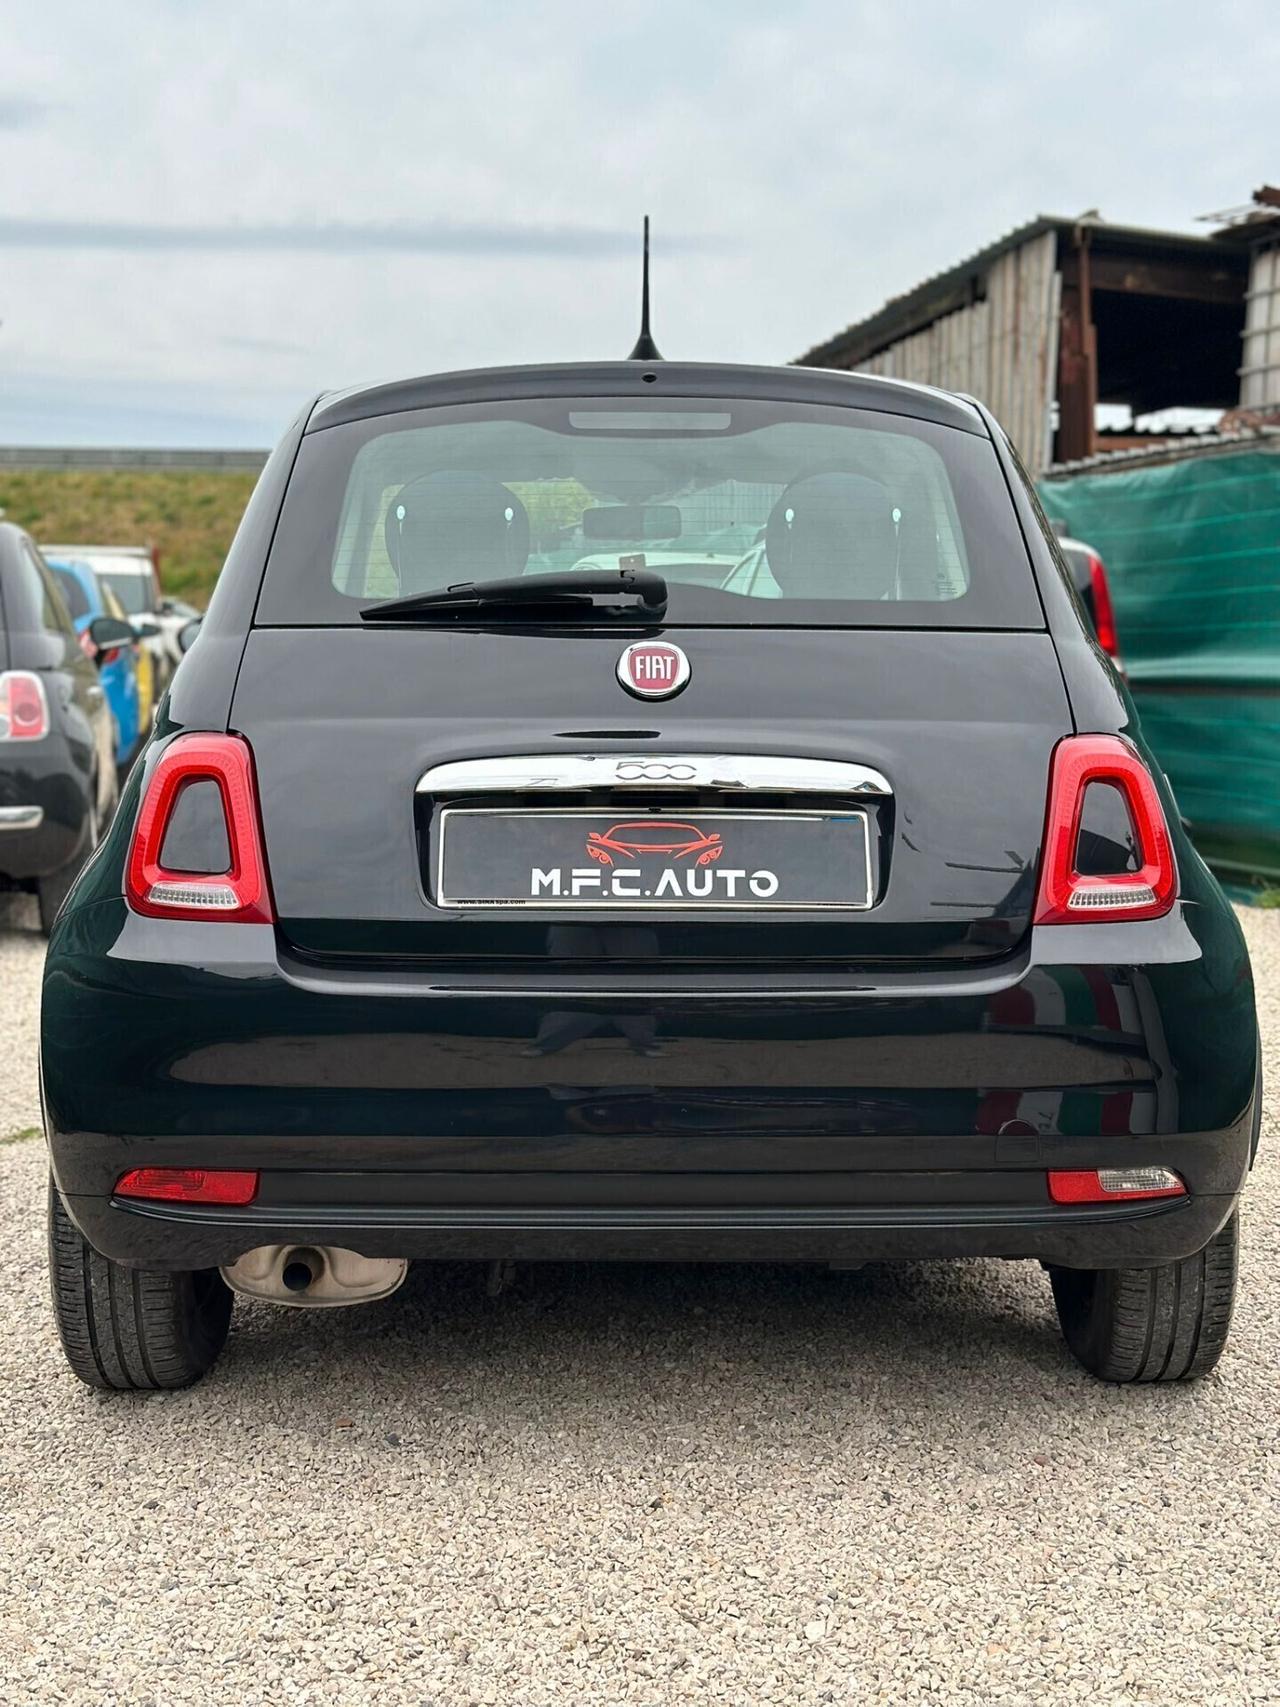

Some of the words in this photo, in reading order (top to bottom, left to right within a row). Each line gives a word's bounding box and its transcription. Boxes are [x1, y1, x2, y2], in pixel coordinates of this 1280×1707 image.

[635, 655, 674, 680] FIAT
[615, 761, 697, 781] 500
[531, 868, 780, 898] M.F.C.AUTO
